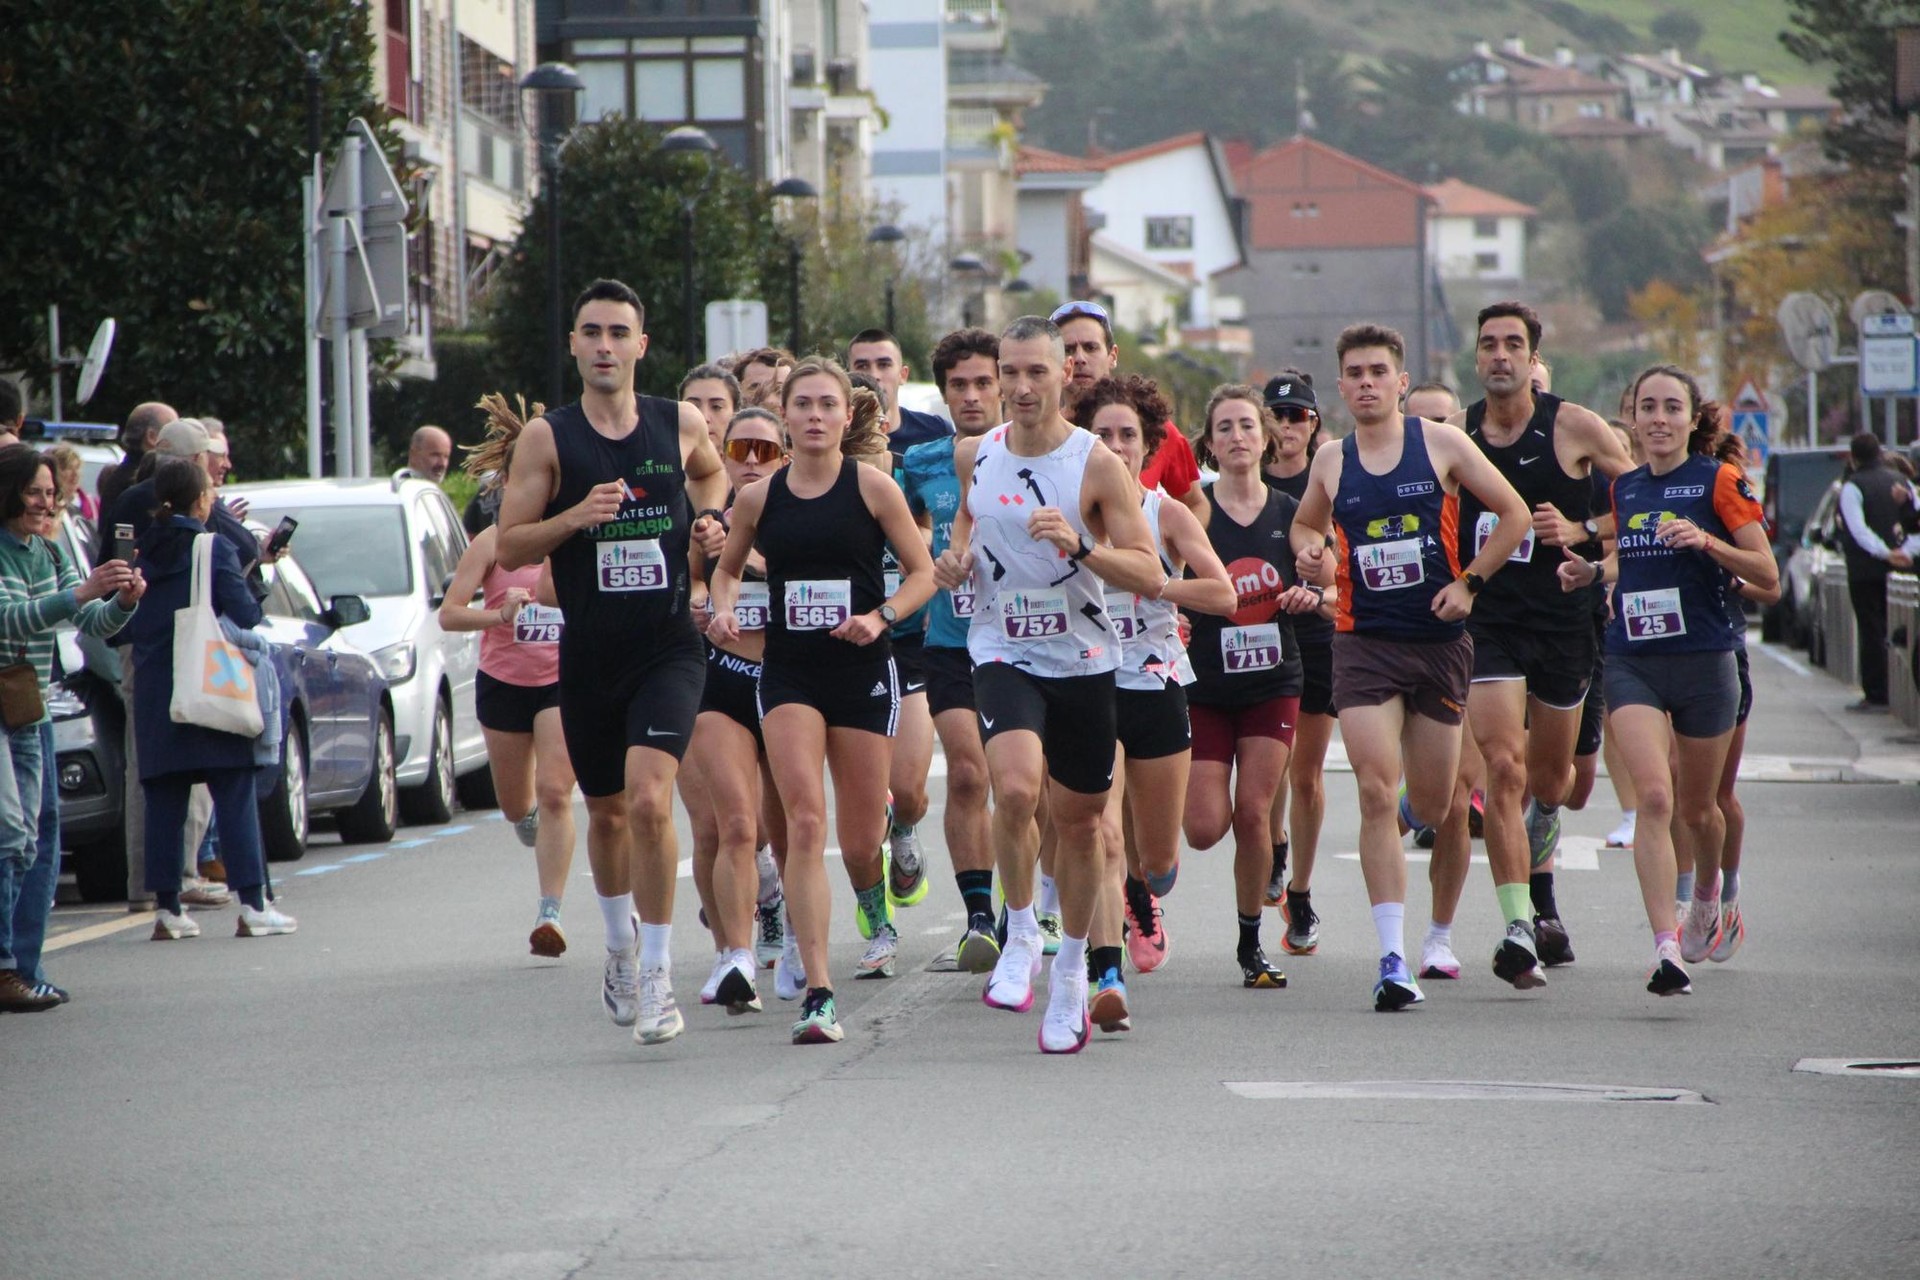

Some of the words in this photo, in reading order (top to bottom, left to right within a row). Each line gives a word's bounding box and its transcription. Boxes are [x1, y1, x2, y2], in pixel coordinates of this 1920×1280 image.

[613, 505, 667, 520] LATEGUI
[609, 566, 656, 587] 565
[1377, 566, 1406, 586] 25
[734, 607, 761, 626] 66
[795, 606, 840, 627] 565
[1012, 615, 1060, 637] 752
[1640, 615, 1667, 635] 25
[523, 624, 560, 640] 779
[1233, 648, 1271, 668] 711
